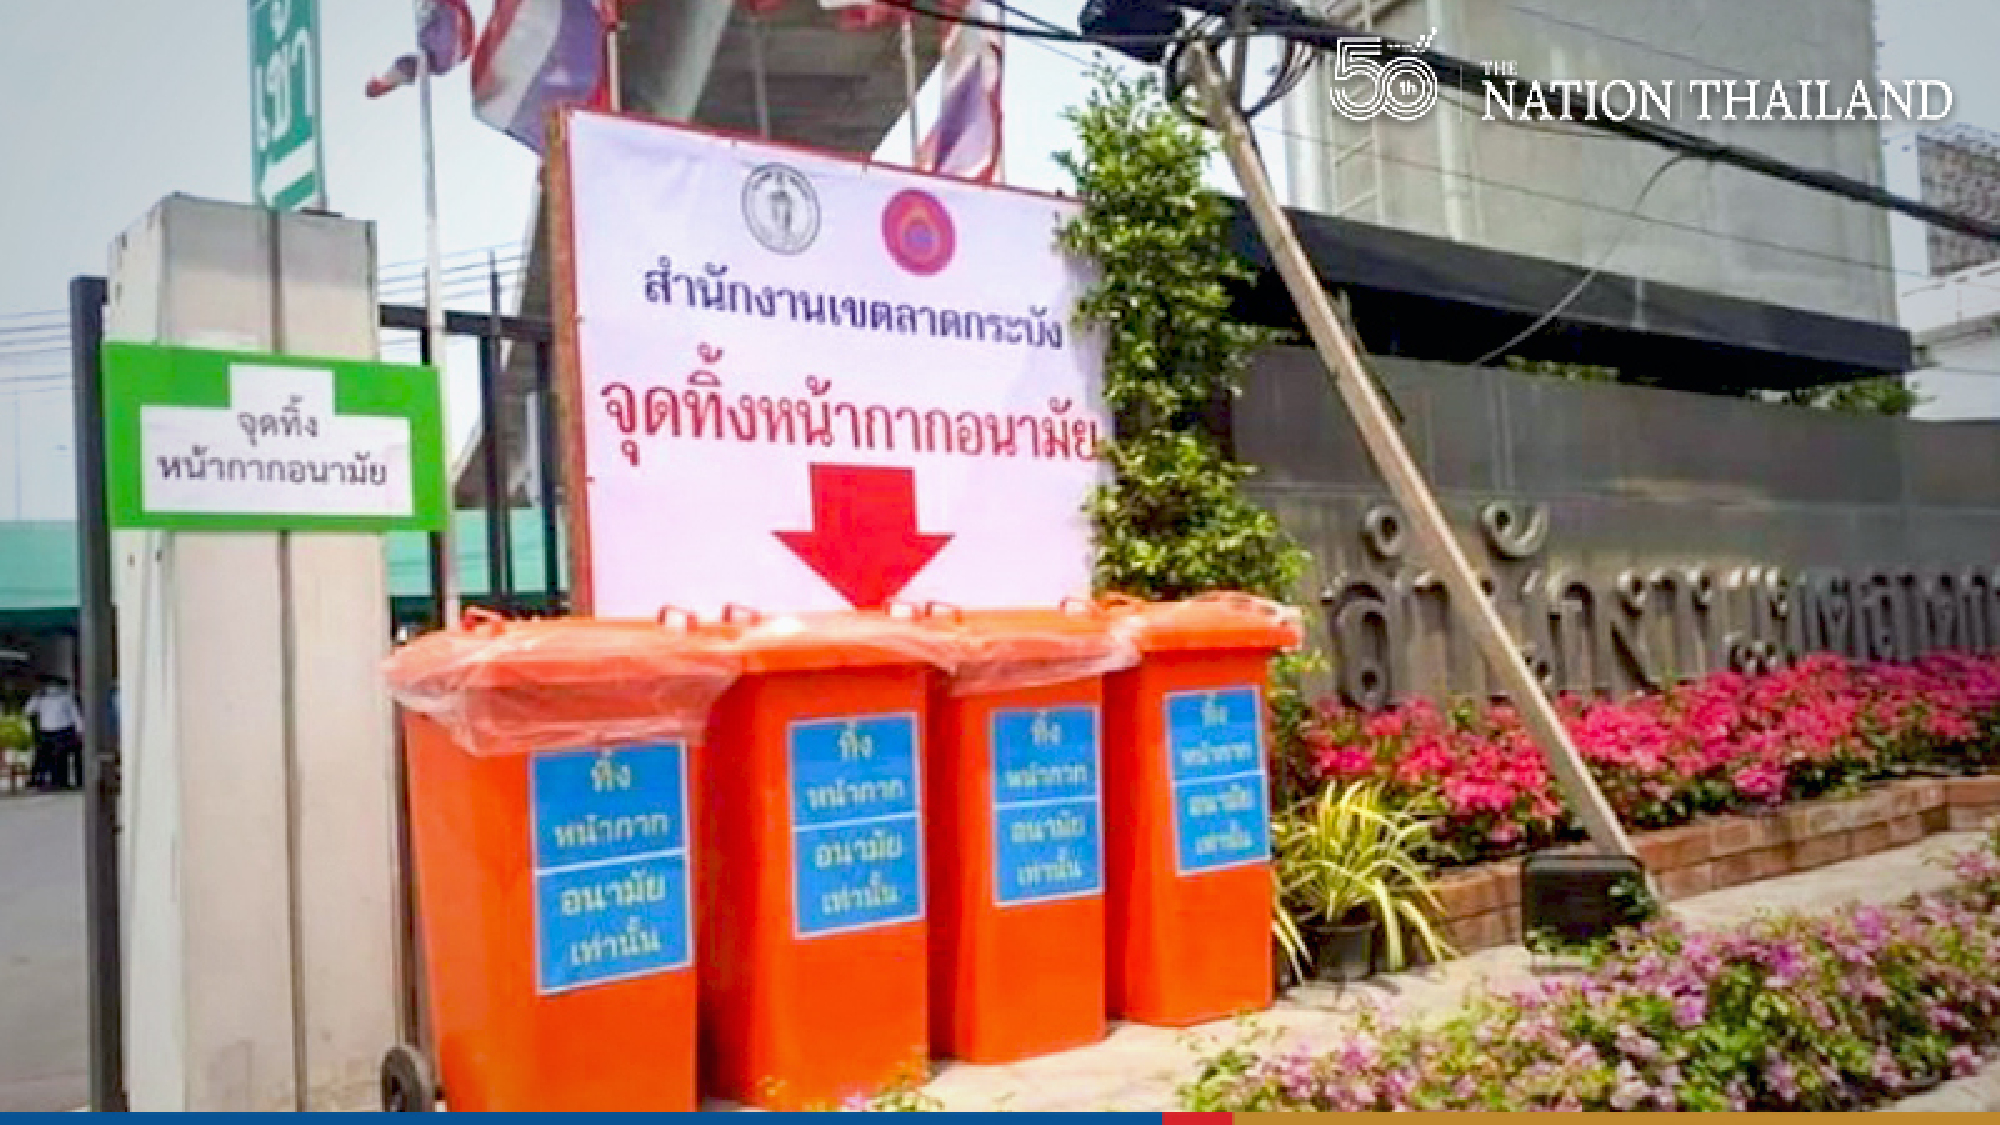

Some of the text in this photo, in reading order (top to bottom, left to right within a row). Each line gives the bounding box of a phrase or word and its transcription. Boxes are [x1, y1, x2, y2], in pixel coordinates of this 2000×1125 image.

[643, 255, 1064, 350] สำนักงานเขตลาดกระบัง
[237, 394, 320, 447] จุดทิ้ง
[600, 342, 1099, 467] จุดทิ้งหน้ากากอนามัย
[157, 444, 388, 487] หน้ากากอนามัย
[554, 814, 670, 848] หน้ากาก
[561, 868, 666, 917] อนามัย
